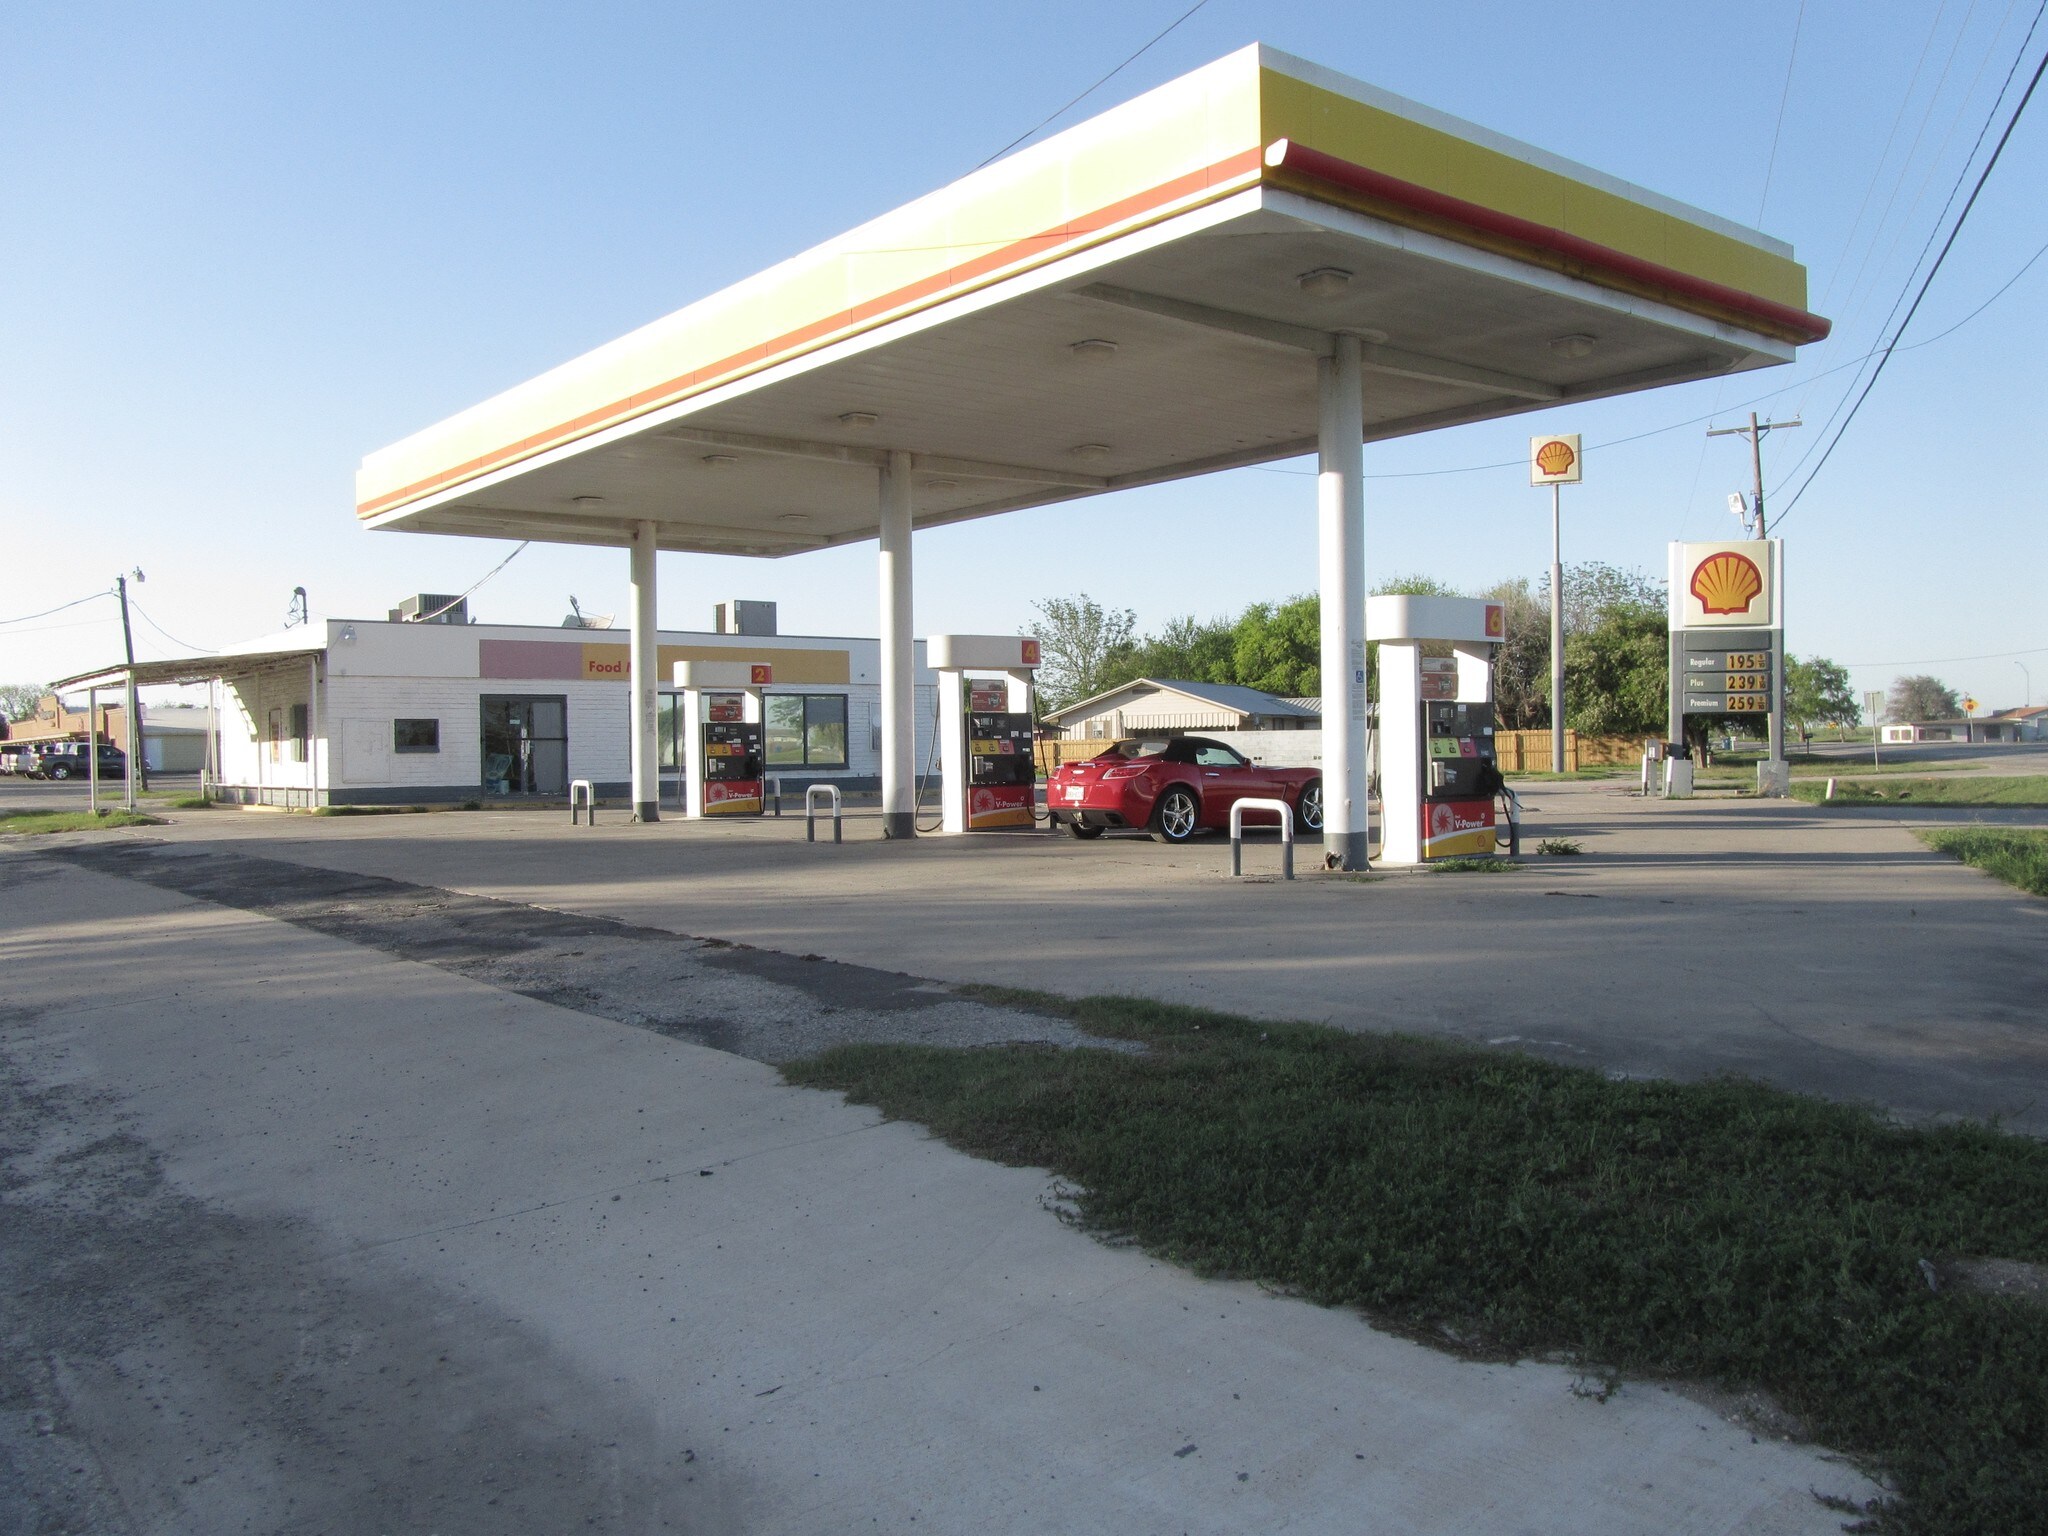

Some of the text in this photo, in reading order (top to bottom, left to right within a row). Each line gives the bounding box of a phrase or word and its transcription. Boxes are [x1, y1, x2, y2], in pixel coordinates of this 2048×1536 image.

[1489, 610, 1501, 633] 6
[1025, 645, 1035, 660] 4
[589, 660, 621, 672] Food
[1690, 658, 1715, 668] Regular
[1730, 655, 1754, 668] 195
[755, 667, 765, 681] 2
[1728, 675, 1755, 689] 239
[1690, 699, 1718, 707] Premium
[1728, 697, 1754, 710] 259
[1455, 819, 1484, 828] V-Power
